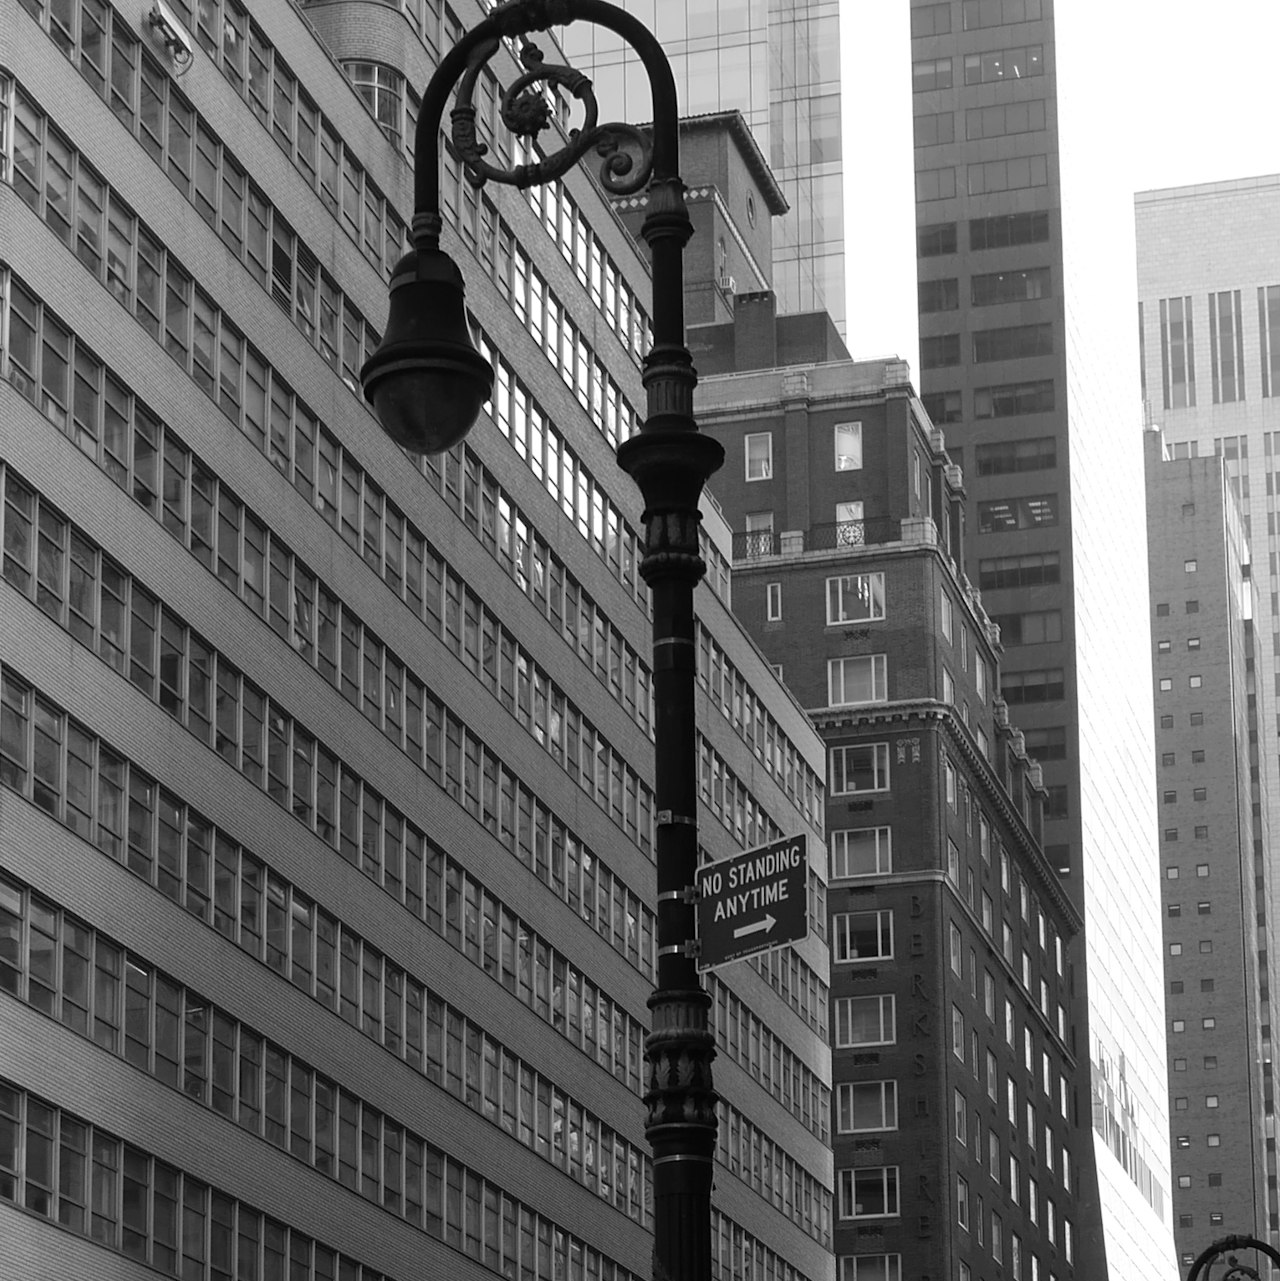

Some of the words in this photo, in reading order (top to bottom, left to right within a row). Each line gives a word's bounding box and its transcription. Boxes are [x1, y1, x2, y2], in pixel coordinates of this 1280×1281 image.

[702, 872, 722, 898] NO
[728, 845, 800, 888] STANDING
[714, 879, 789, 922] ANYTIME
